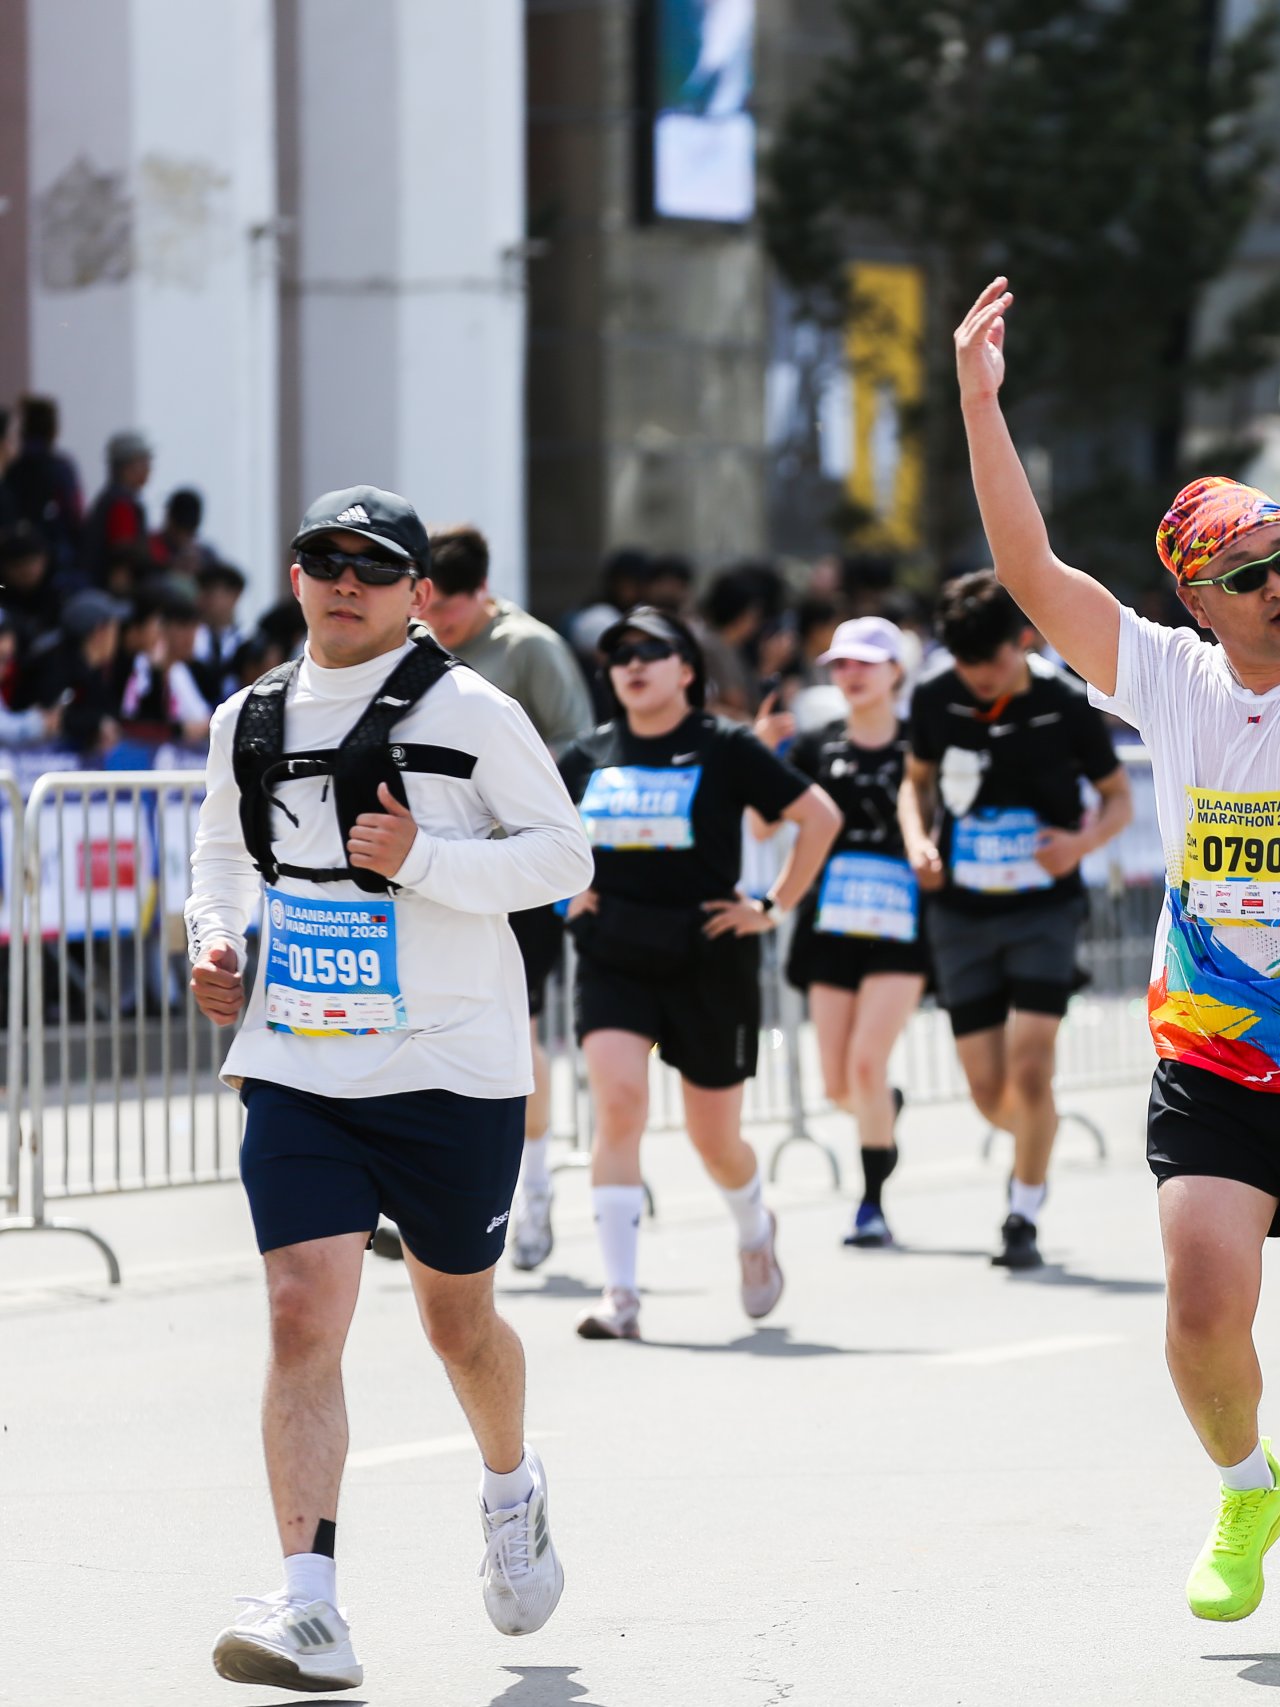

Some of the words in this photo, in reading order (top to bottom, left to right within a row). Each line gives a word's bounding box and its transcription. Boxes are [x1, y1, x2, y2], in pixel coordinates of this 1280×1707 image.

[1198, 812, 1274, 827] MARATHON
[285, 904, 370, 924] ULAANBAATAR
[286, 919, 350, 938] MARATHON
[351, 926, 389, 938] 2026
[289, 943, 381, 986] 01599
